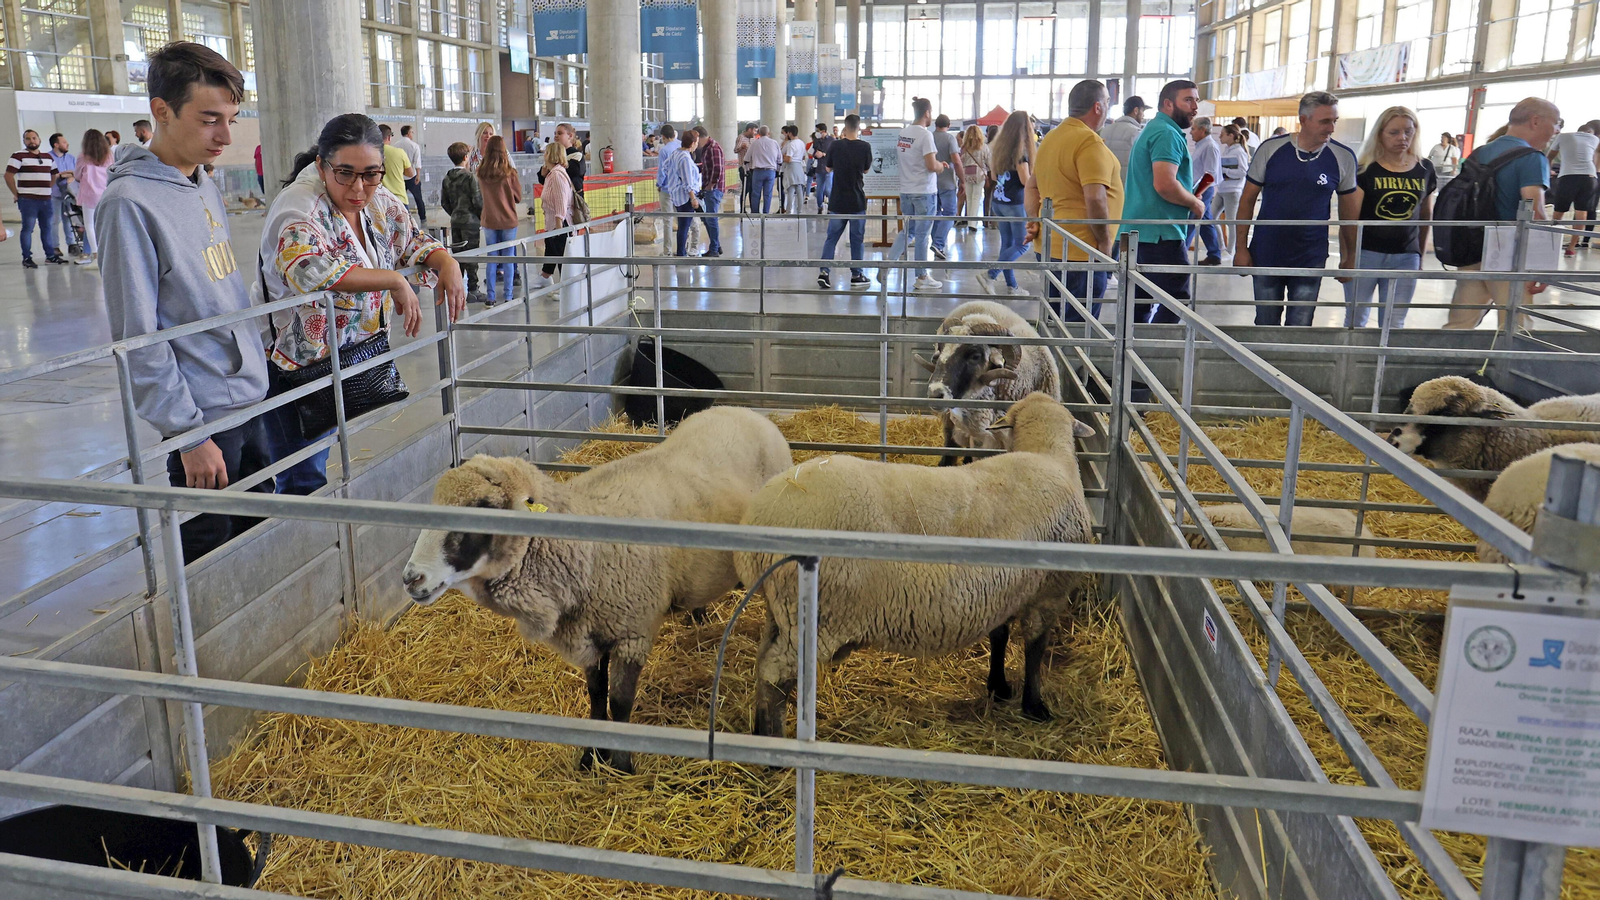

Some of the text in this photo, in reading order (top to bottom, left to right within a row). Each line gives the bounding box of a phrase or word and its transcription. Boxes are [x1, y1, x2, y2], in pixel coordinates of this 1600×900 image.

[1374, 176, 1426, 192] NIRVANA
[1496, 730, 1542, 743] MERINA
[1546, 737, 1562, 746] DE
[1520, 744, 1562, 756] CENTRO
[1455, 806, 1494, 817] ESTADO
[1497, 811, 1510, 819] DE
[1498, 801, 1557, 814] HEMBRAS
